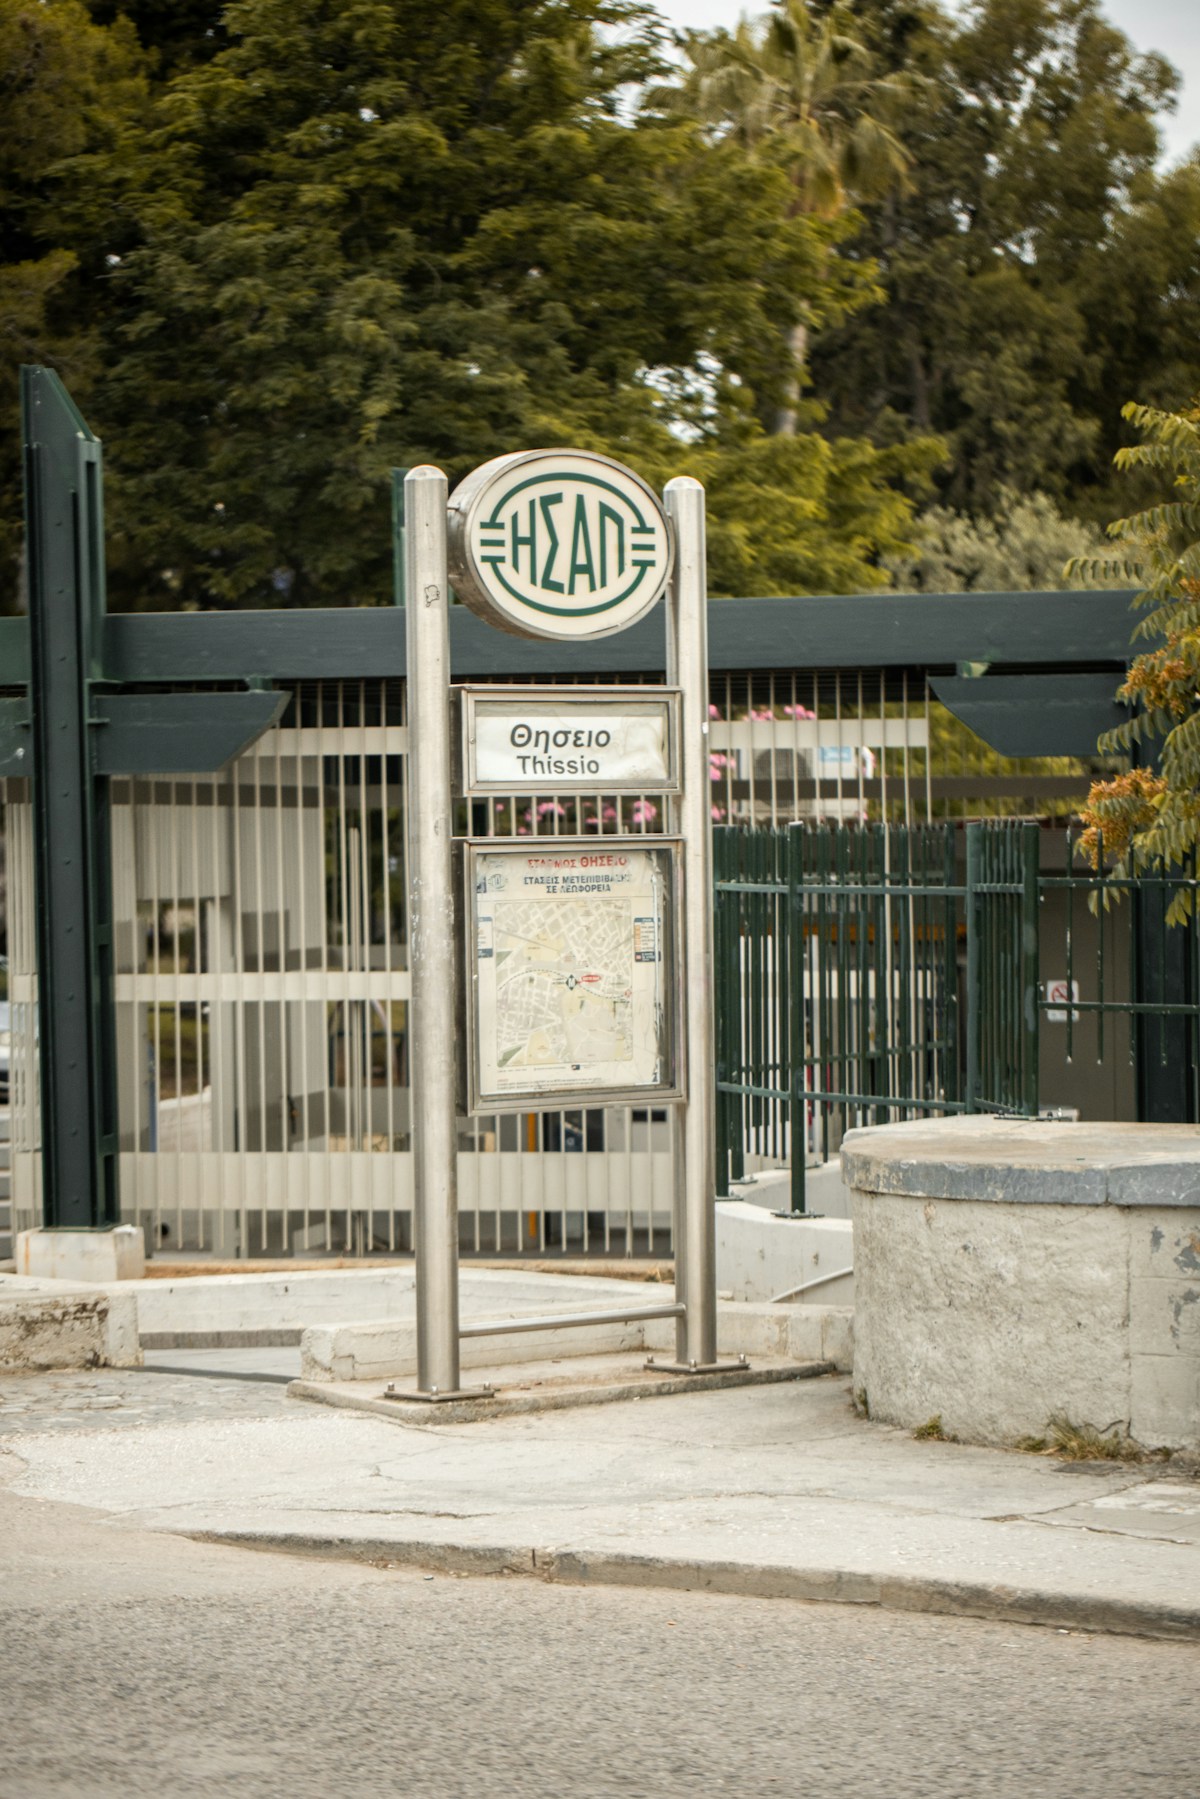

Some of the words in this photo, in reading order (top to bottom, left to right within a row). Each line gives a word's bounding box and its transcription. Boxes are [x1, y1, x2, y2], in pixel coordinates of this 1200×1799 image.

[511, 492, 625, 595] ΗΣΑΠ
[510, 723, 611, 753] Θησειο
[516, 755, 600, 774] Thissio
[528, 858, 577, 868] ΣΤΑΜΟΣ
[546, 885, 558, 893] ΣΕ
